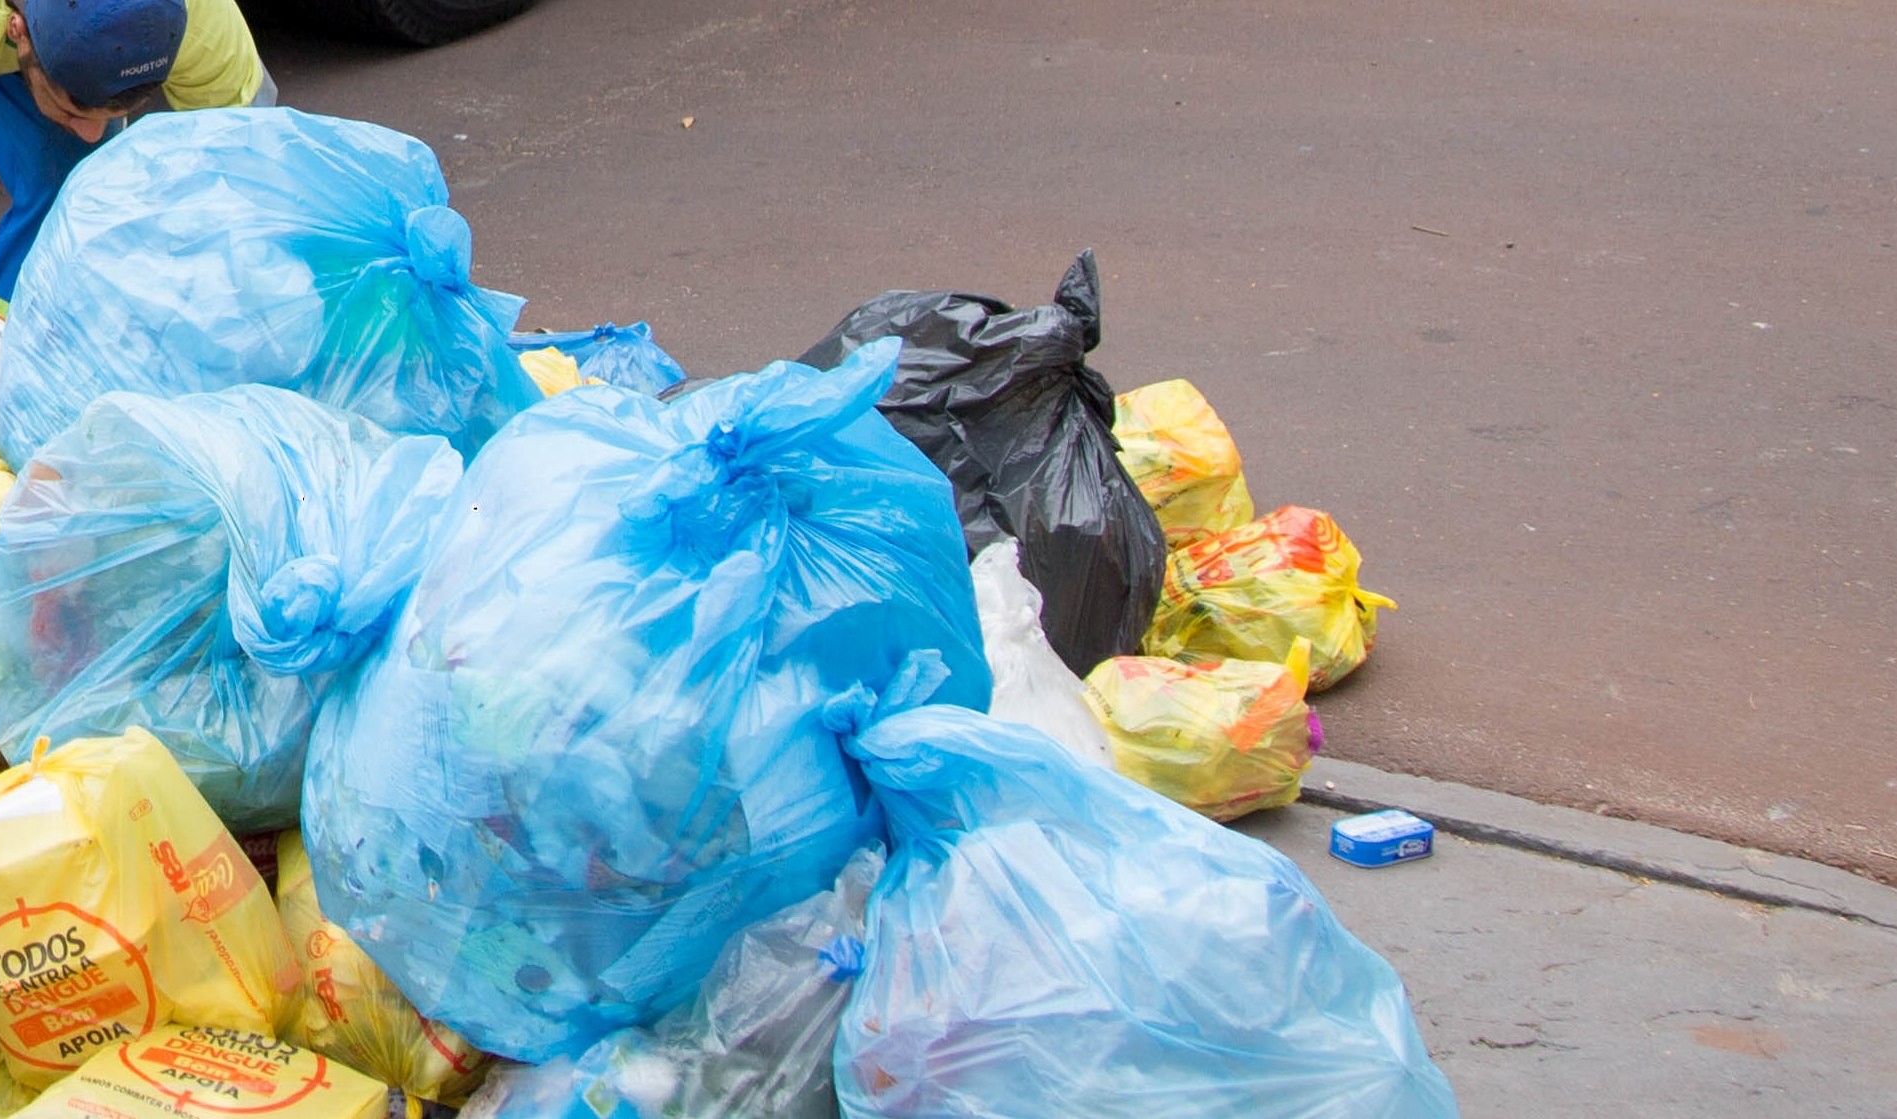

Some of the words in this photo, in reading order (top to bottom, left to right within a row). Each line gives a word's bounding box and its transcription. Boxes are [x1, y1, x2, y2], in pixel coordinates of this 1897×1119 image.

[120, 56, 169, 78] HOUSTON
[78, 955, 97, 971] A
[4, 966, 110, 1016] DENGUE
[40, 1006, 97, 1032] Bom
[58, 1021, 131, 1059] APOIA
[164, 1038, 281, 1076] DENGUE
[173, 1056, 235, 1080] Bom
[112, 1082, 162, 1108] COMBATER
[160, 1067, 240, 1100] APOIA
